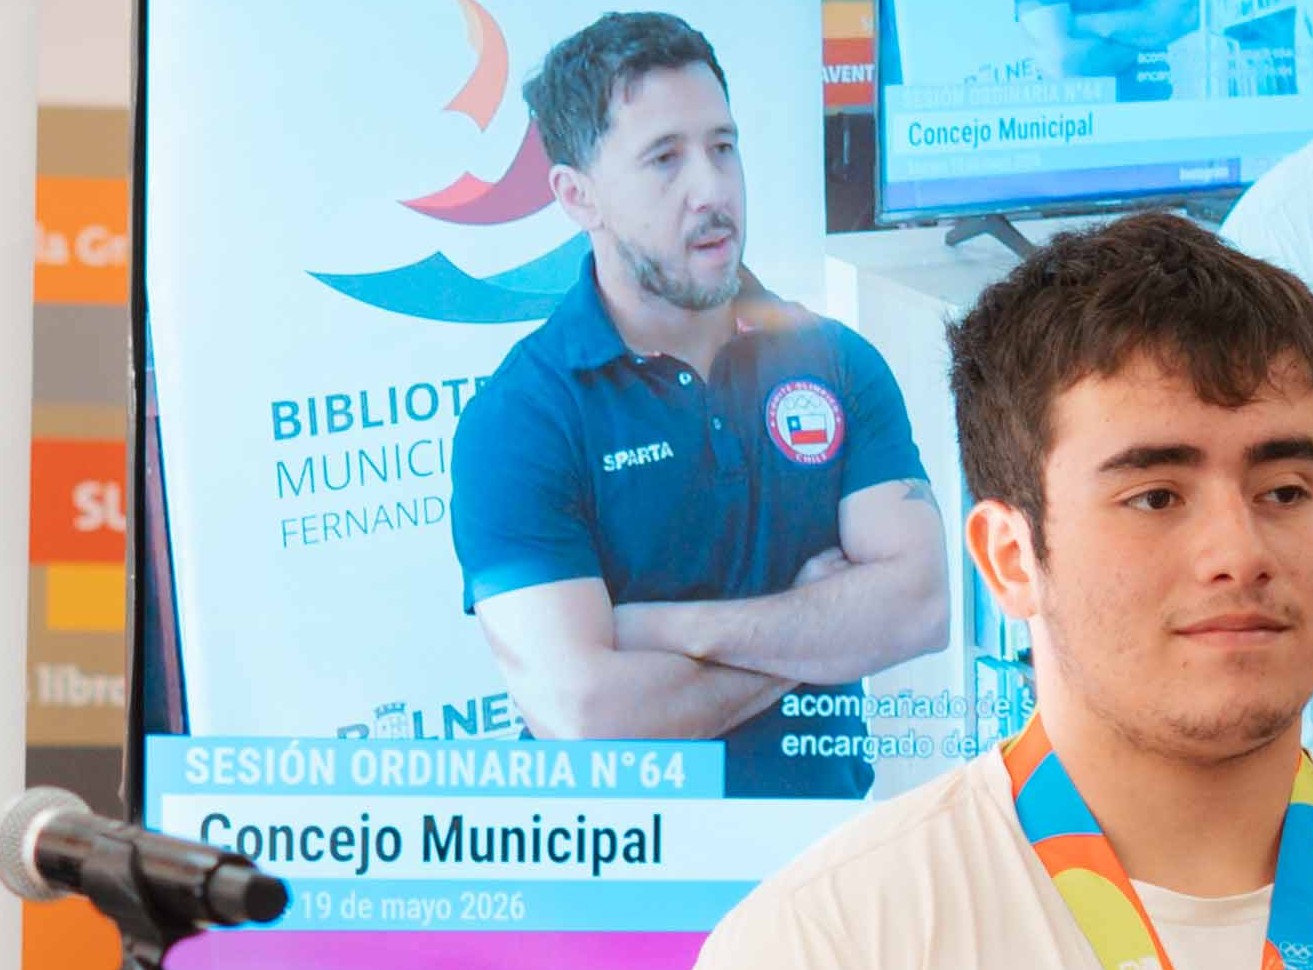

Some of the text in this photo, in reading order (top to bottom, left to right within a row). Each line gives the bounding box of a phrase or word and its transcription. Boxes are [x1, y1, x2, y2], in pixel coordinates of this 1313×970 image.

[909, 112, 1093, 148] Concejo Municipal
[276, 438, 445, 499] MUNICI
[603, 441, 674, 472] SPARTA
[281, 496, 446, 548] FERNAND
[781, 689, 967, 721] acompañado
[976, 690, 1010, 719] de
[185, 741, 686, 788] SESIÓN ORDINARIA N°64
[781, 730, 933, 763] encargado
[942, 730, 977, 760] de
[200, 812, 662, 877] Concejo Municipal
[302, 890, 526, 926] 19 de mayo 2026
